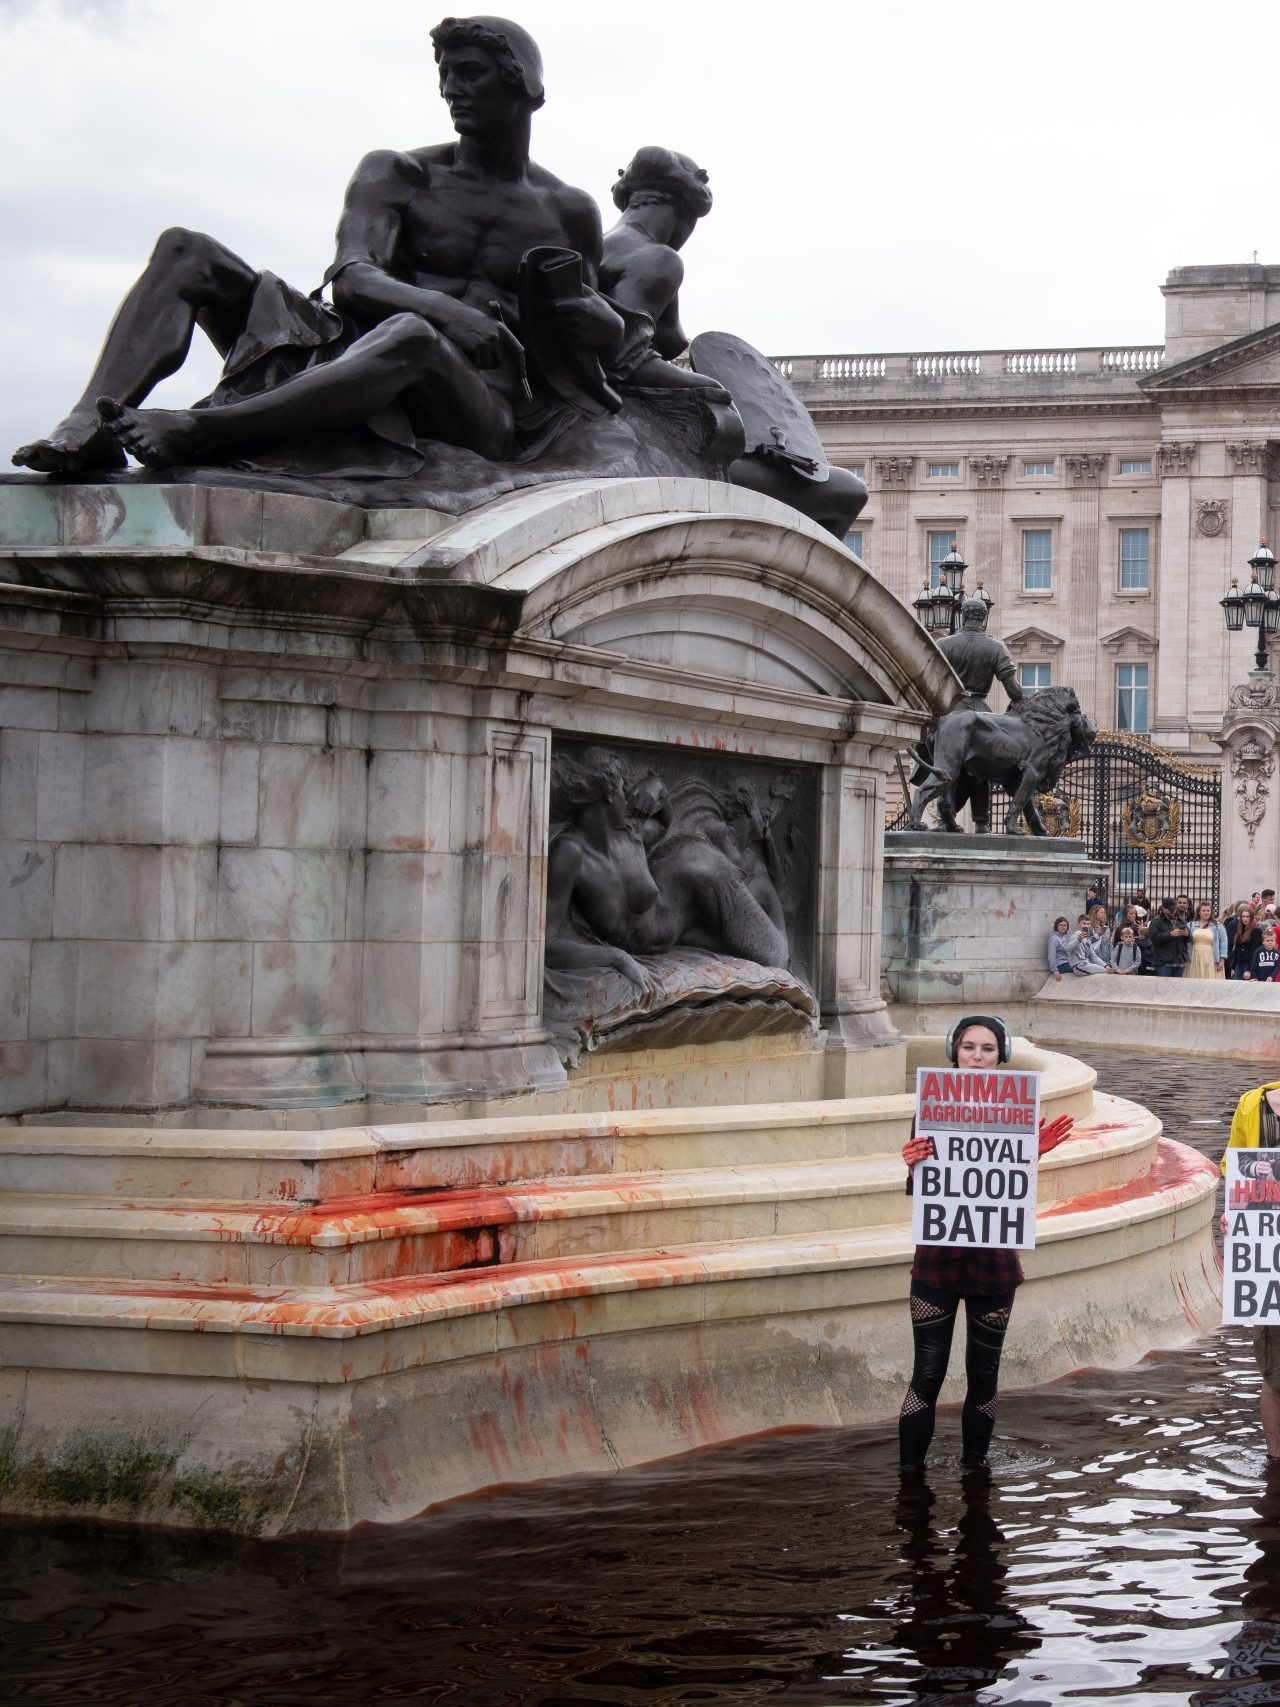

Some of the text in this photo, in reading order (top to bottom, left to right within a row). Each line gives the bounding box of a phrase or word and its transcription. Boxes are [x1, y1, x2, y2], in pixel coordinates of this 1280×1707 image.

[921, 1072, 1036, 1104] ANIMAL
[921, 1104, 1034, 1126] AGRICULTURE
[948, 1136, 1031, 1164] ROYAL
[921, 1166, 1029, 1200] BLOOD
[922, 1203, 1025, 1245] BATH
[1232, 1212, 1249, 1237] A
